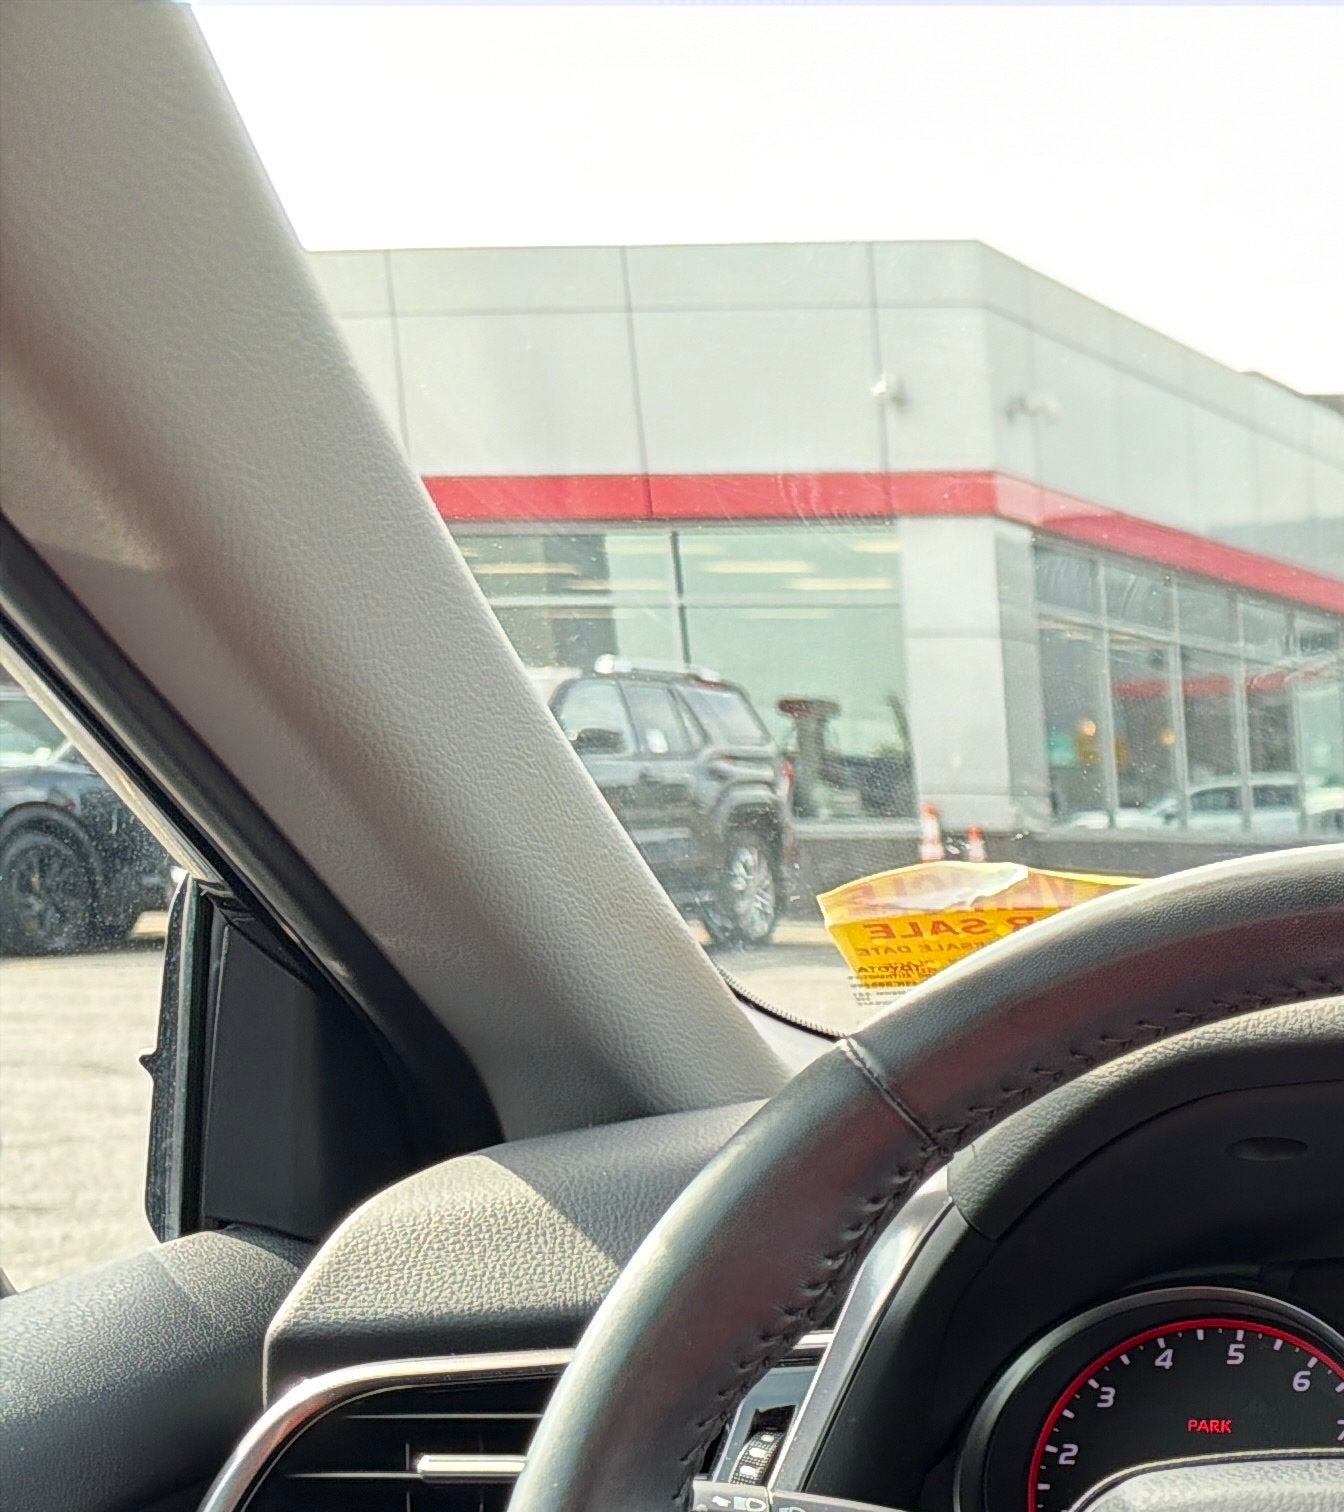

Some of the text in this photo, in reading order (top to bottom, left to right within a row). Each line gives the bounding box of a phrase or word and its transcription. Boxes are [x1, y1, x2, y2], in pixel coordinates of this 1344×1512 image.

[1154, 1348, 1175, 1370] 4
[1226, 1343, 1246, 1366] 5
[1292, 1370, 1311, 1393] 6
[1096, 1386, 1116, 1408] 3
[1187, 1418, 1232, 1433] PARK
[1058, 1444, 1079, 1466] 2
